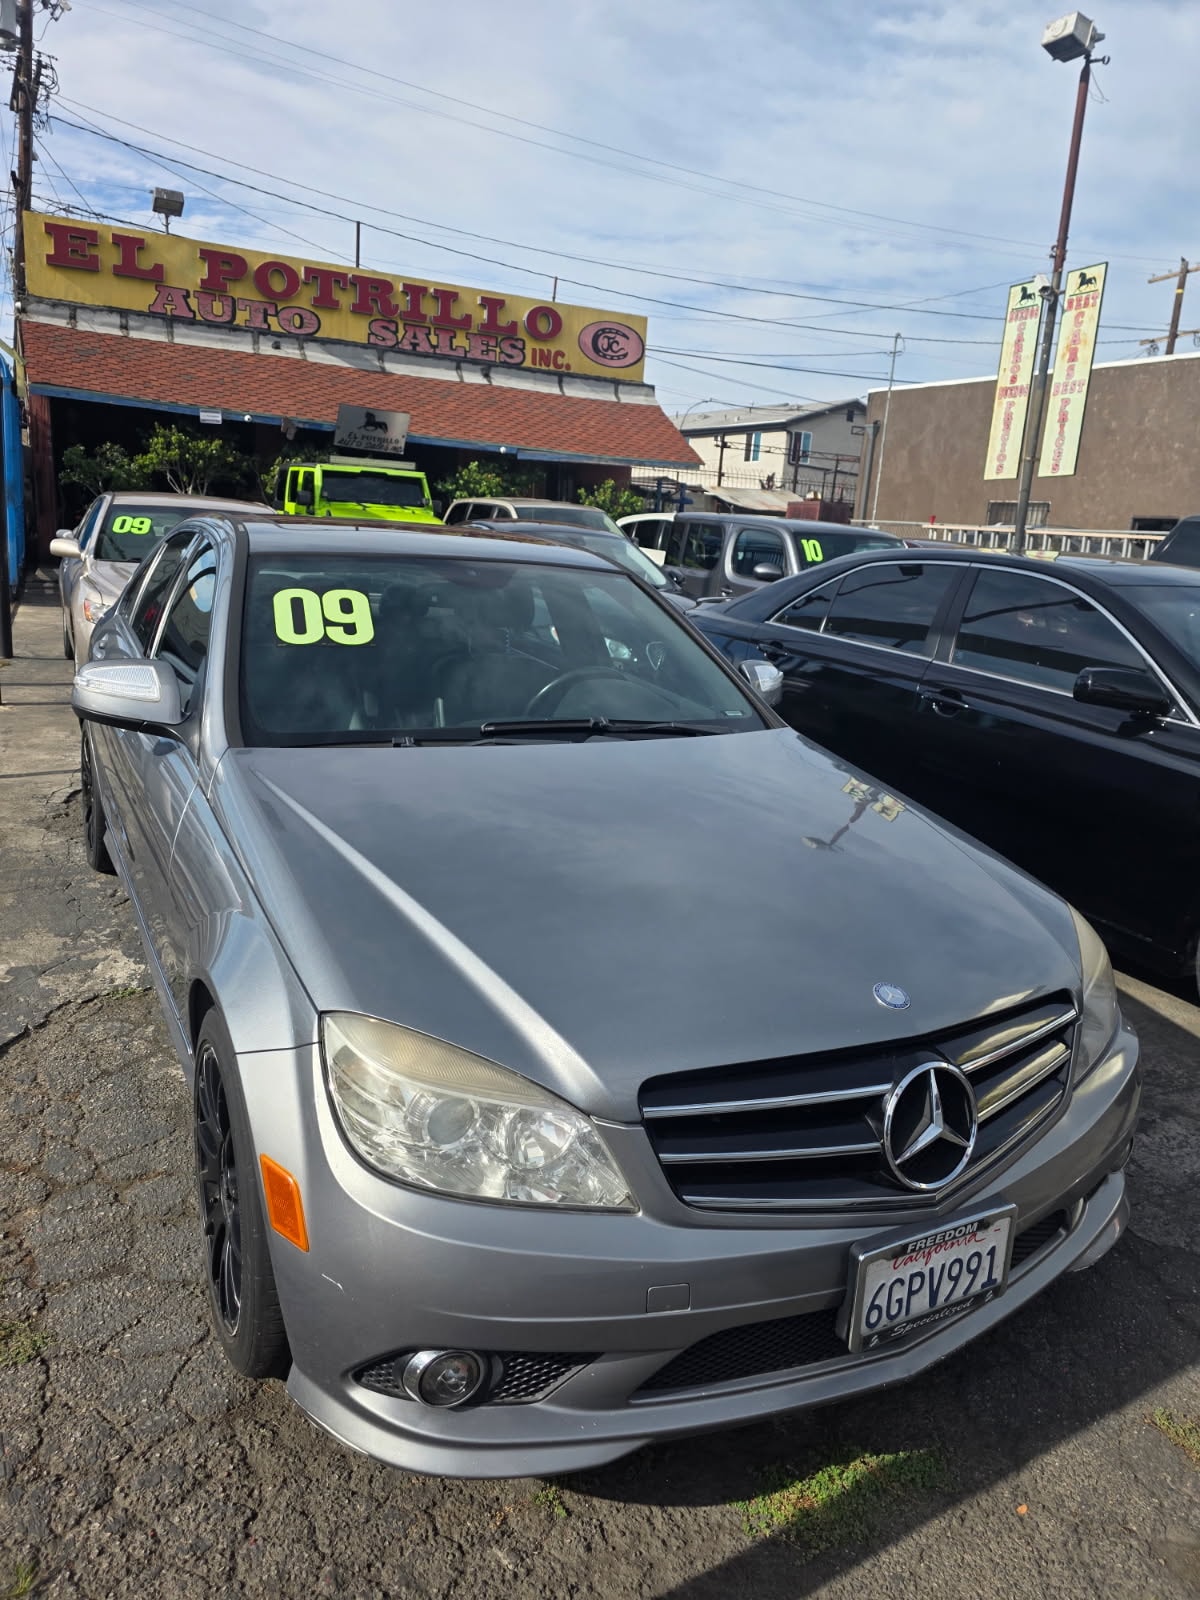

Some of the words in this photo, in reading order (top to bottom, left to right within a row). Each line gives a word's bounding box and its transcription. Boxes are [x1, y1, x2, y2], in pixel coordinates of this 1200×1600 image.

[44, 222, 164, 282] EL
[199, 248, 564, 341] POTRILLO
[1065, 290, 1100, 312] BEST
[149, 285, 321, 335] AUTO
[368, 318, 525, 365] SALES
[531, 348, 571, 371] INC.
[1052, 379, 1086, 396] BEST
[112, 516, 152, 535] 09
[801, 539, 823, 562] 10
[273, 588, 375, 645] 09
[892, 1232, 986, 1270] California
[907, 1222, 979, 1253] FREEDOM
[865, 1245, 998, 1329] 6GPV991
